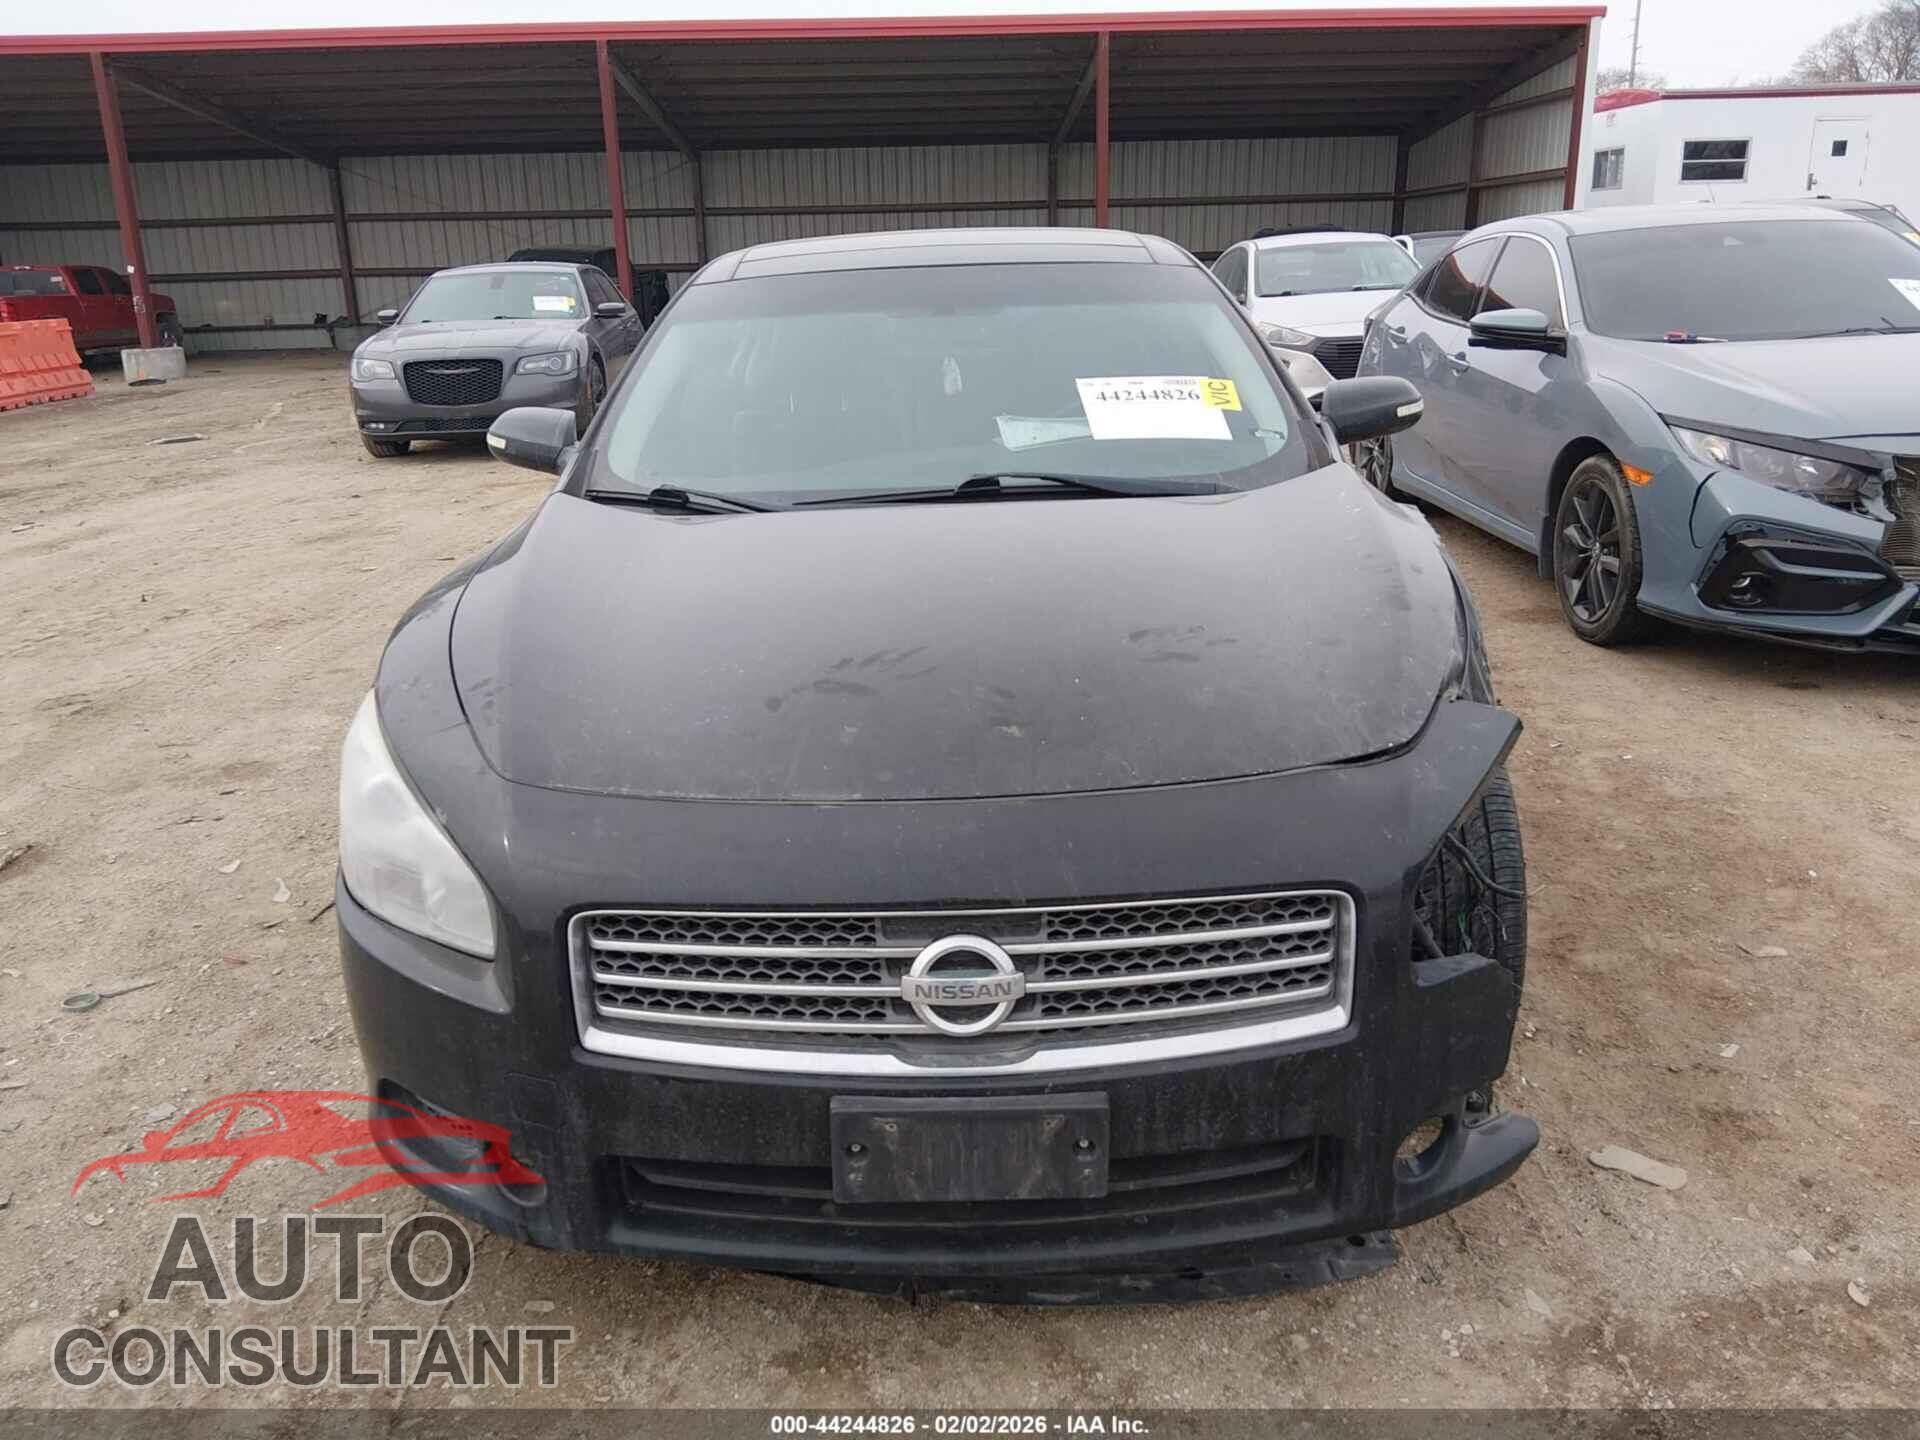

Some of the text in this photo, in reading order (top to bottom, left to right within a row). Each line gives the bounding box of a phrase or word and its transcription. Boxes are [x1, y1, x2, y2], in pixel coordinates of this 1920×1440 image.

[1096, 389, 1201, 402] 44244826
[1207, 380, 1232, 407] VIC
[914, 981, 1013, 1000] NISSAN
